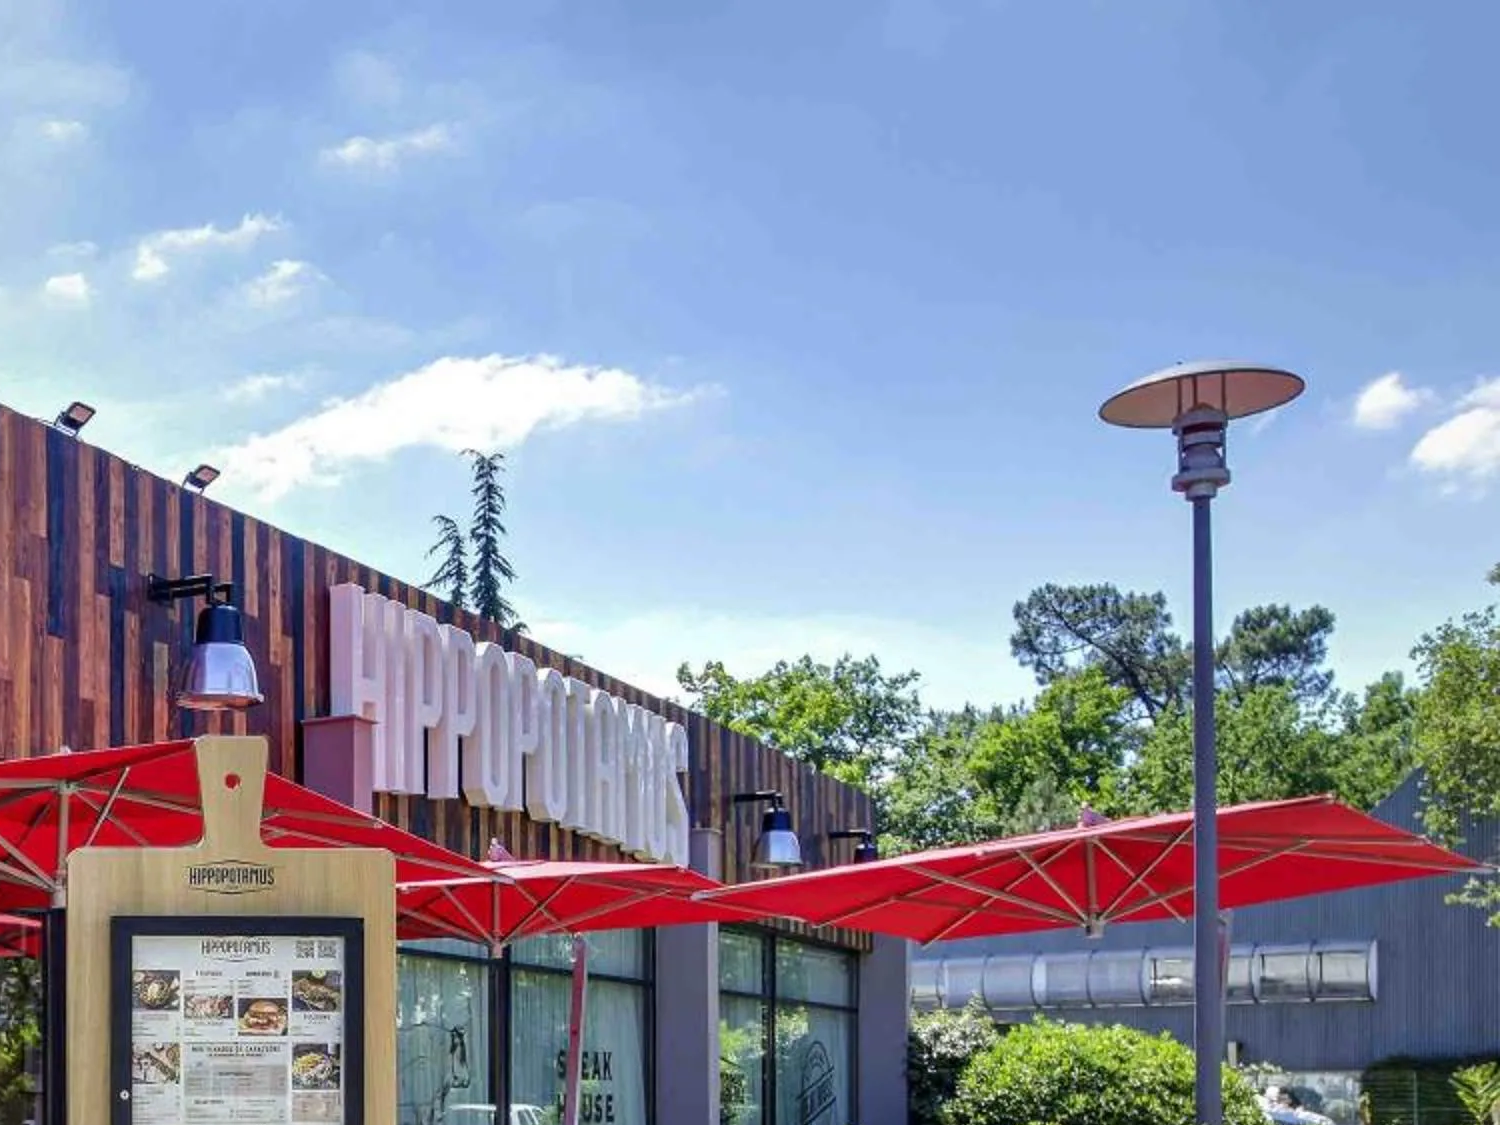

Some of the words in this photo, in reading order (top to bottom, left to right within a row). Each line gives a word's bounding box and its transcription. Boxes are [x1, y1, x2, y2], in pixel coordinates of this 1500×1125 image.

[330, 583, 688, 866] HIPPOPOTAMUS
[189, 866, 275, 885] HIPPOPOTAMUS
[201, 938, 271, 954] HIPPOPOTAMUS
[556, 1049, 613, 1081] SEAK
[556, 1092, 615, 1124] HUSE
